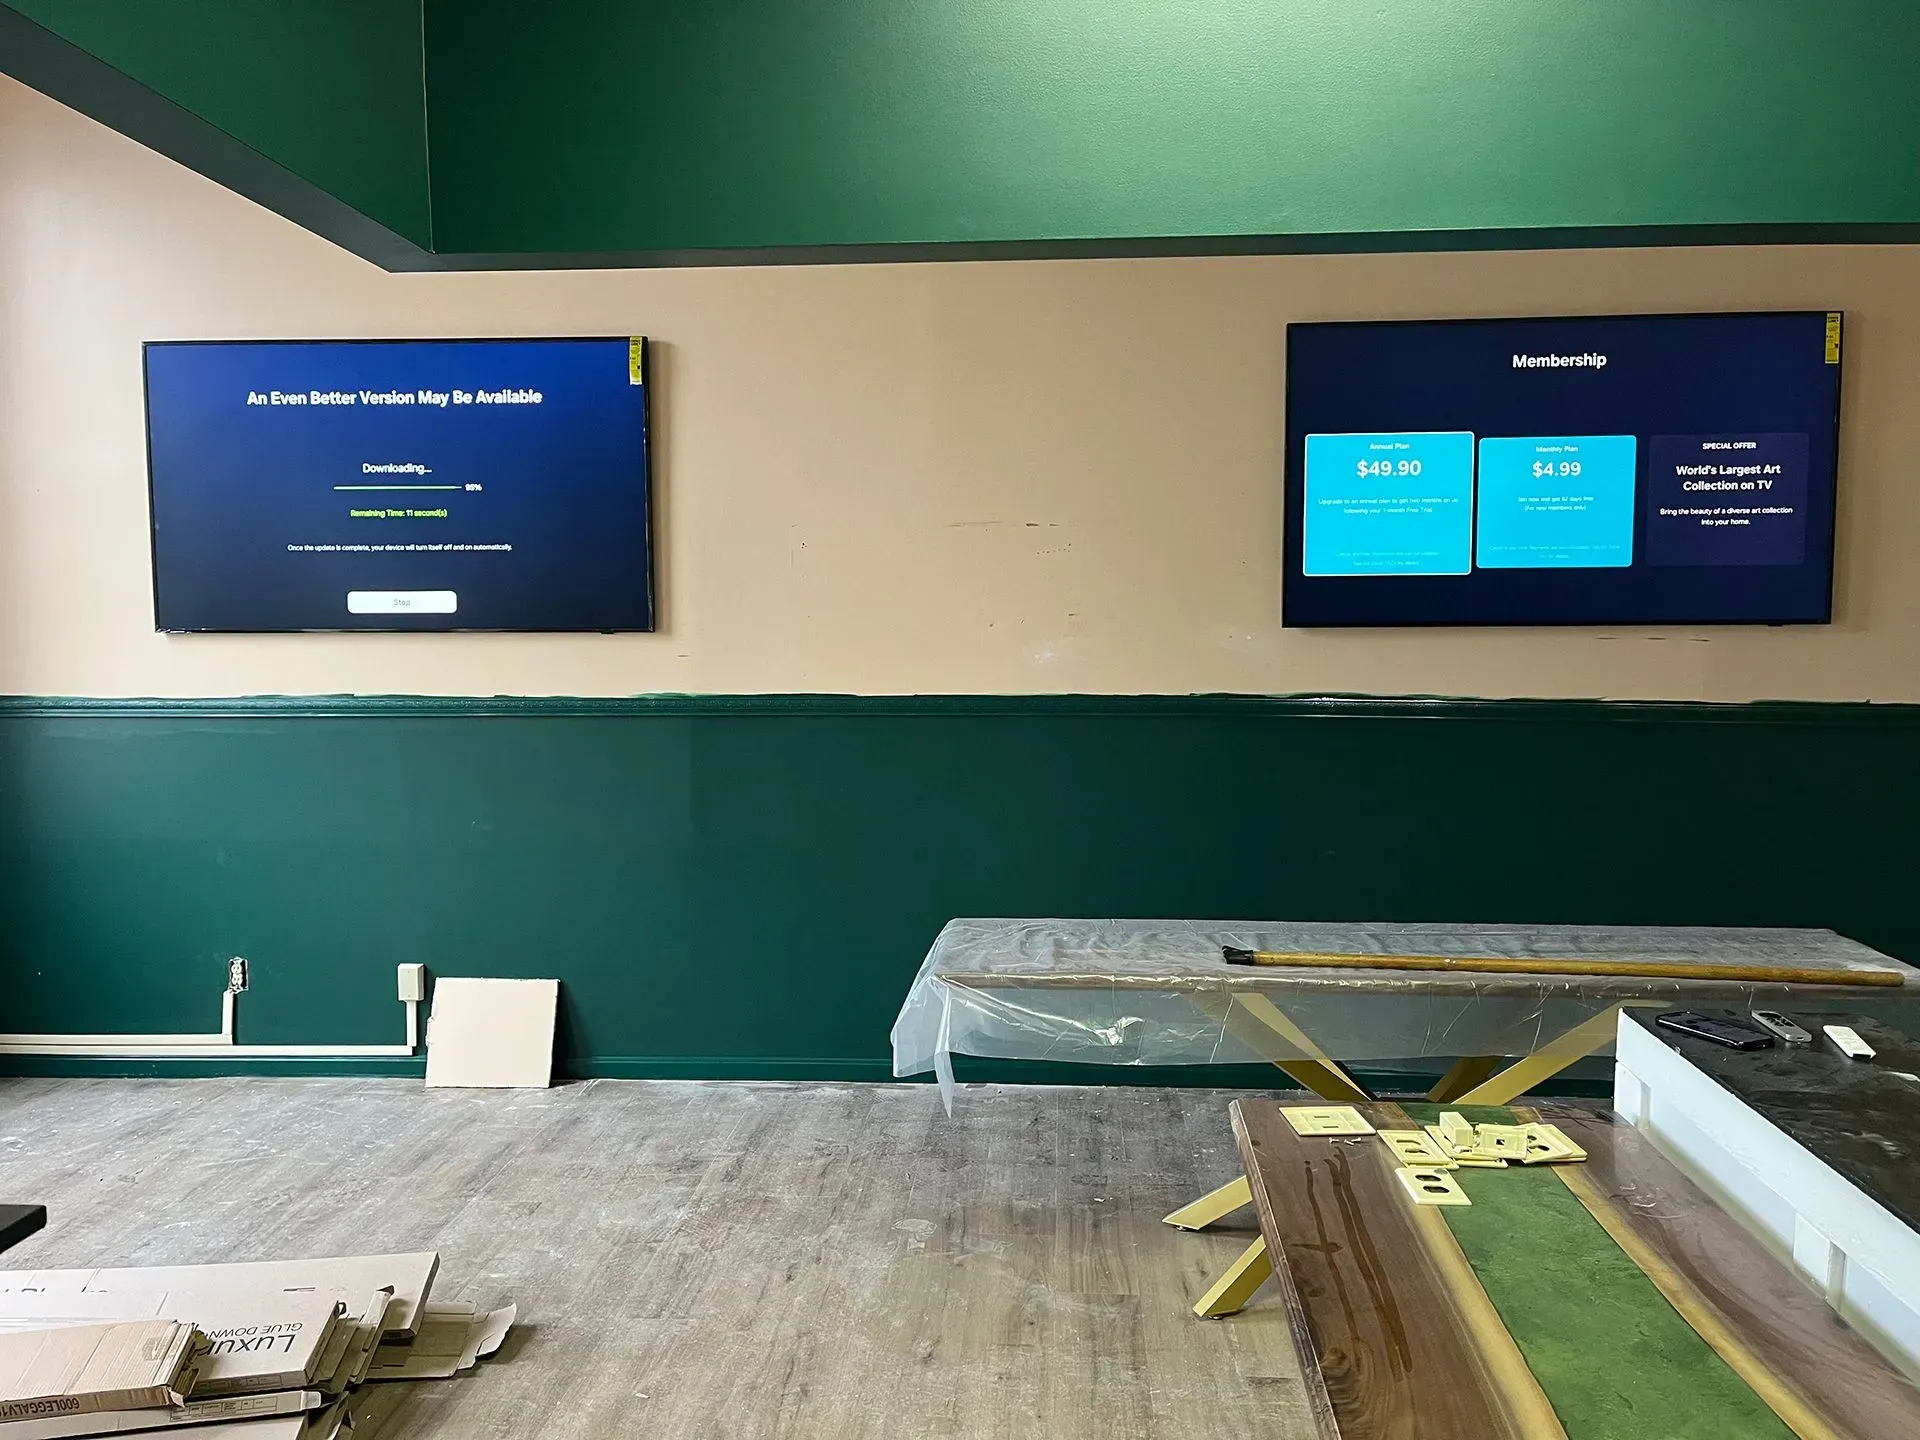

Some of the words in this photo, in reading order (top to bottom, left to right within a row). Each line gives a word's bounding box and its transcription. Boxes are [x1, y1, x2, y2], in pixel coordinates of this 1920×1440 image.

[1512, 353, 1607, 370] Membership
[247, 391, 268, 405] An
[270, 391, 307, 405] Even
[310, 390, 357, 405] Better
[359, 389, 415, 405] Version
[418, 390, 449, 407] May
[452, 390, 473, 404] Be
[475, 389, 543, 404] Available
[362, 463, 433, 475] Downloading...
[1356, 459, 1422, 478] $49.90
[1532, 461, 1581, 478] $4.99
[1676, 465, 1717, 475] World's
[1719, 465, 1761, 477] Largest
[1763, 464, 1781, 474] Art
[1683, 480, 1738, 491] Collection
[1740, 481, 1755, 490] on
[1757, 480, 1773, 490] TV
[350, 509, 386, 518] Remaining
[387, 509, 405, 517] Time:
[414, 509, 448, 517] second(s)
[1660, 508, 1677, 516] Bring
[342, 544, 371, 552] complete,
[393, 599, 411, 607] Stop
[209, 1326, 258, 1338] DOWN
[261, 1322, 303, 1334] GLUE
